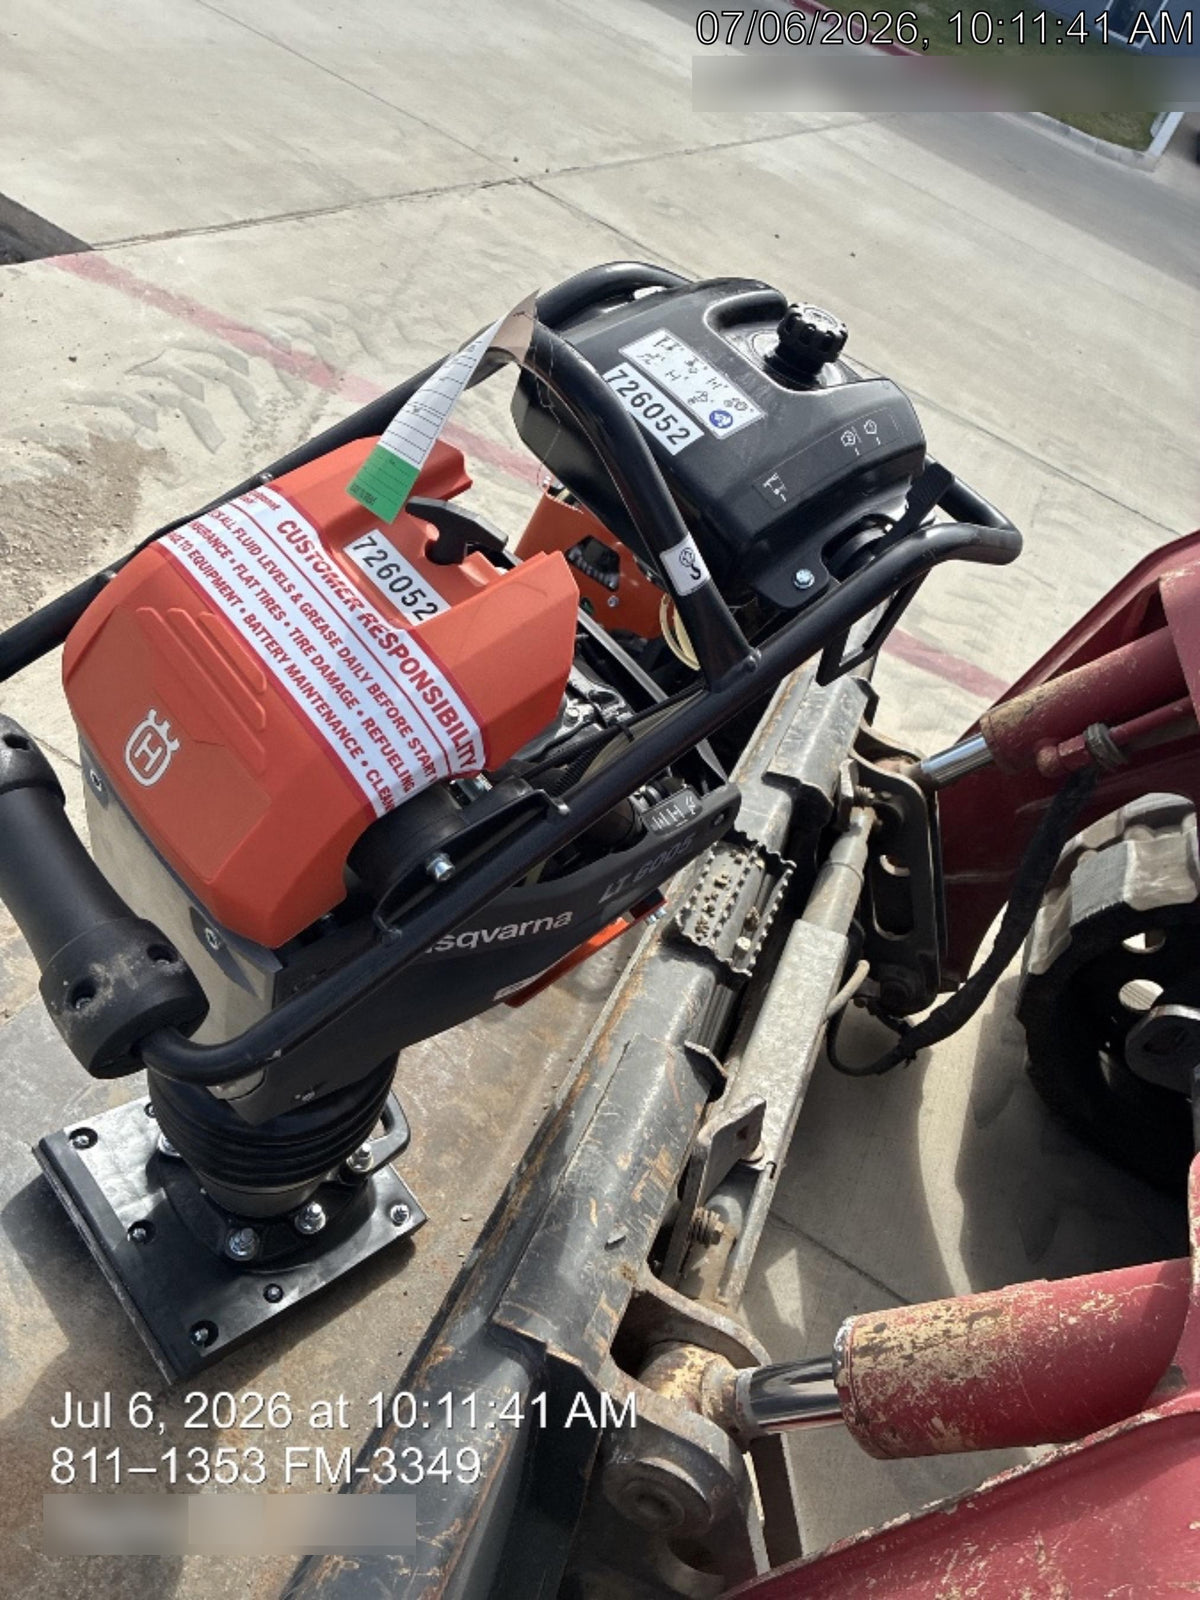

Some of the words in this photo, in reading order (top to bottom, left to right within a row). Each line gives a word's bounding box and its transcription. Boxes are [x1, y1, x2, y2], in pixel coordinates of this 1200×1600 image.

[606, 369, 690, 445] 726052
[187, 549, 244, 607] EQUIPMENT
[242, 613, 291, 664] BATTERY
[284, 663, 365, 760] MAINTENANCE
[232, 528, 262, 556] FLUID
[257, 554, 296, 593] LEVELS
[290, 593, 303, 605] &
[299, 602, 343, 649] GREASE
[337, 647, 373, 683] DAILY
[366, 682, 414, 738] BEFORE
[407, 737, 437, 777] START
[232, 563, 260, 590] FLAT
[254, 588, 287, 622] TIRES
[289, 627, 317, 656] TIRE
[310, 654, 360, 709] DAMAGE
[361, 717, 416, 793] REFUELING
[276, 520, 365, 612] CUSTOMER
[357, 611, 476, 768] RESPONSIBILITY
[352, 535, 439, 621] 726052
[424, 911, 573, 953] sqvarna
